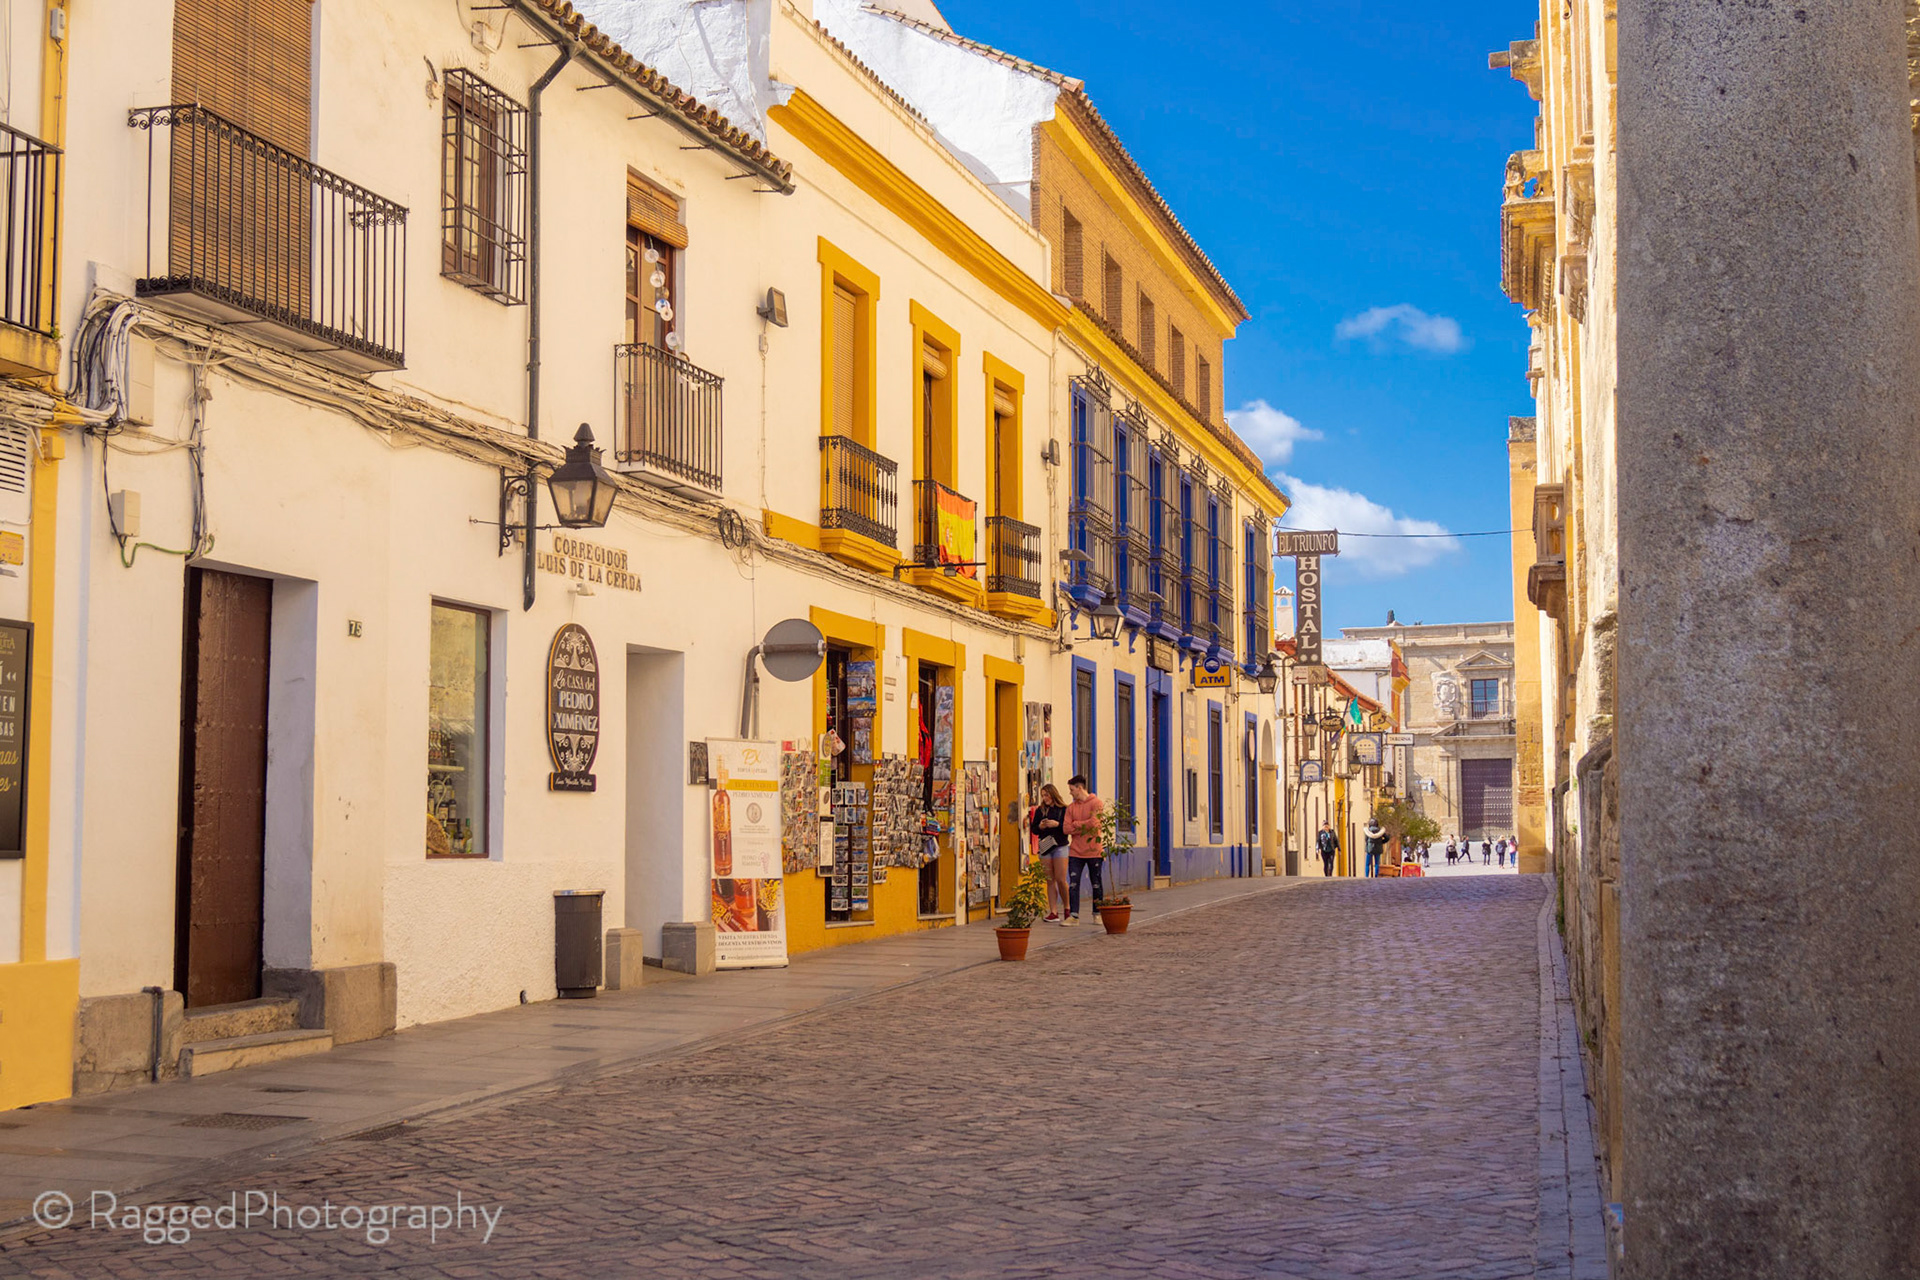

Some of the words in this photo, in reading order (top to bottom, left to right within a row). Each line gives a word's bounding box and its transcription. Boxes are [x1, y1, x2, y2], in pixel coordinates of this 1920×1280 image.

[1278, 534, 1291, 552] EL
[1292, 533, 1336, 552] TRIUNFO
[554, 536, 629, 571] CORREGIDOR
[537, 552, 566, 575] LUIS
[570, 560, 584, 579] DE
[588, 564, 602, 584] LA
[606, 570, 642, 592] CERDA
[1298, 556, 1318, 649] HOSTAL
[349, 621, 362, 638] 75
[553, 669, 566, 689] La
[566, 675, 584, 690] CASA
[1200, 676, 1224, 684] ATM
[558, 690, 594, 711] PEDRO
[553, 711, 598, 732] XIMÉNEZ
